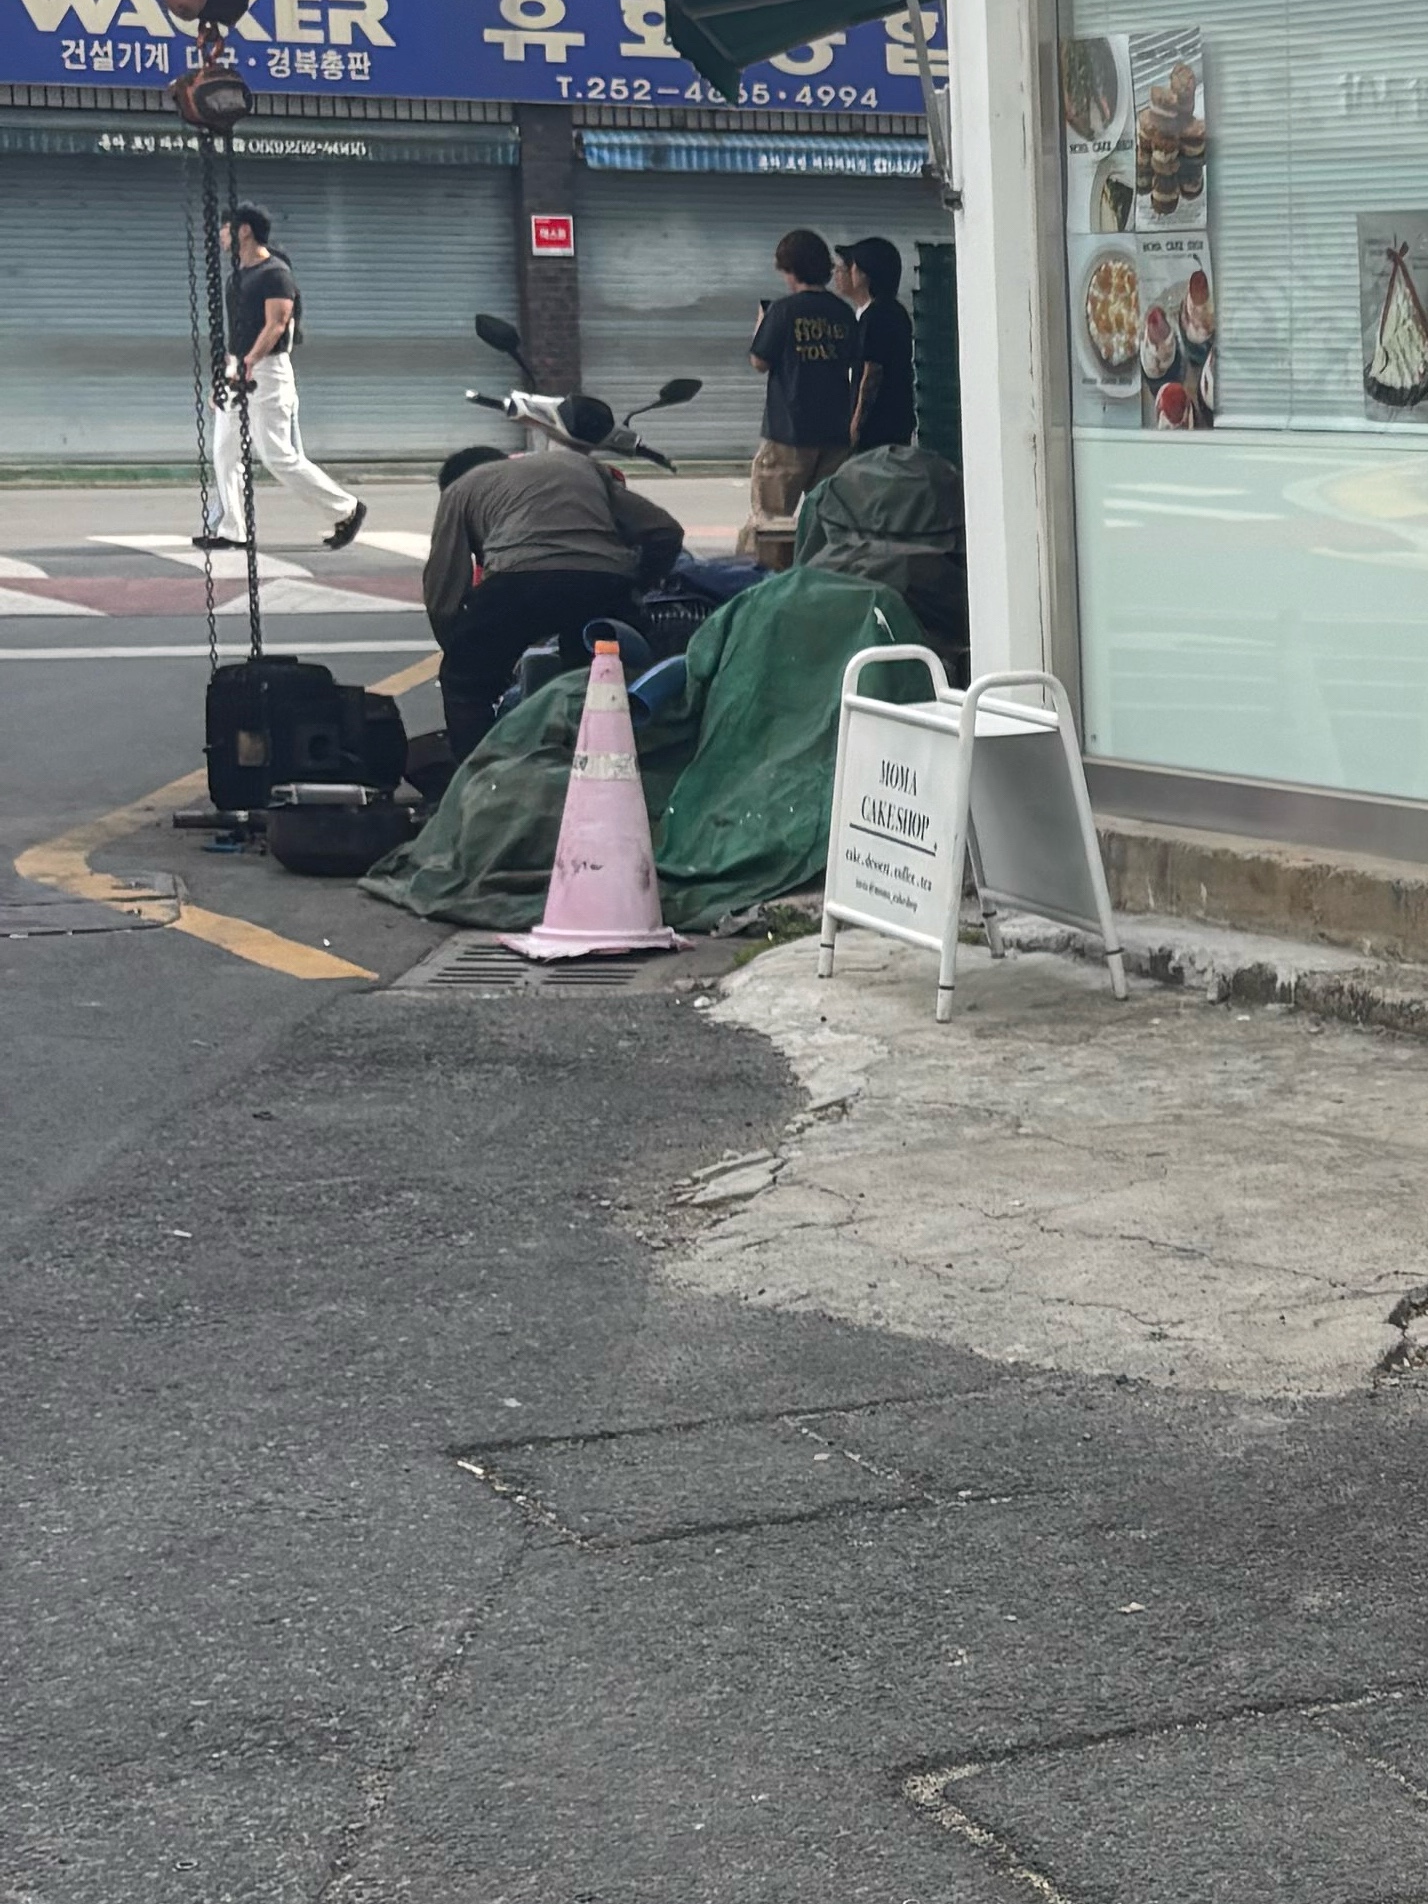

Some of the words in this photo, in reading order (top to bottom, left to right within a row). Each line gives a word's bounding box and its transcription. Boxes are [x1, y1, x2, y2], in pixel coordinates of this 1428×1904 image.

[61, 39, 170, 74] 건설기계
[266, 47, 372, 82] 경북총판
[879, 758, 917, 796] MOMA
